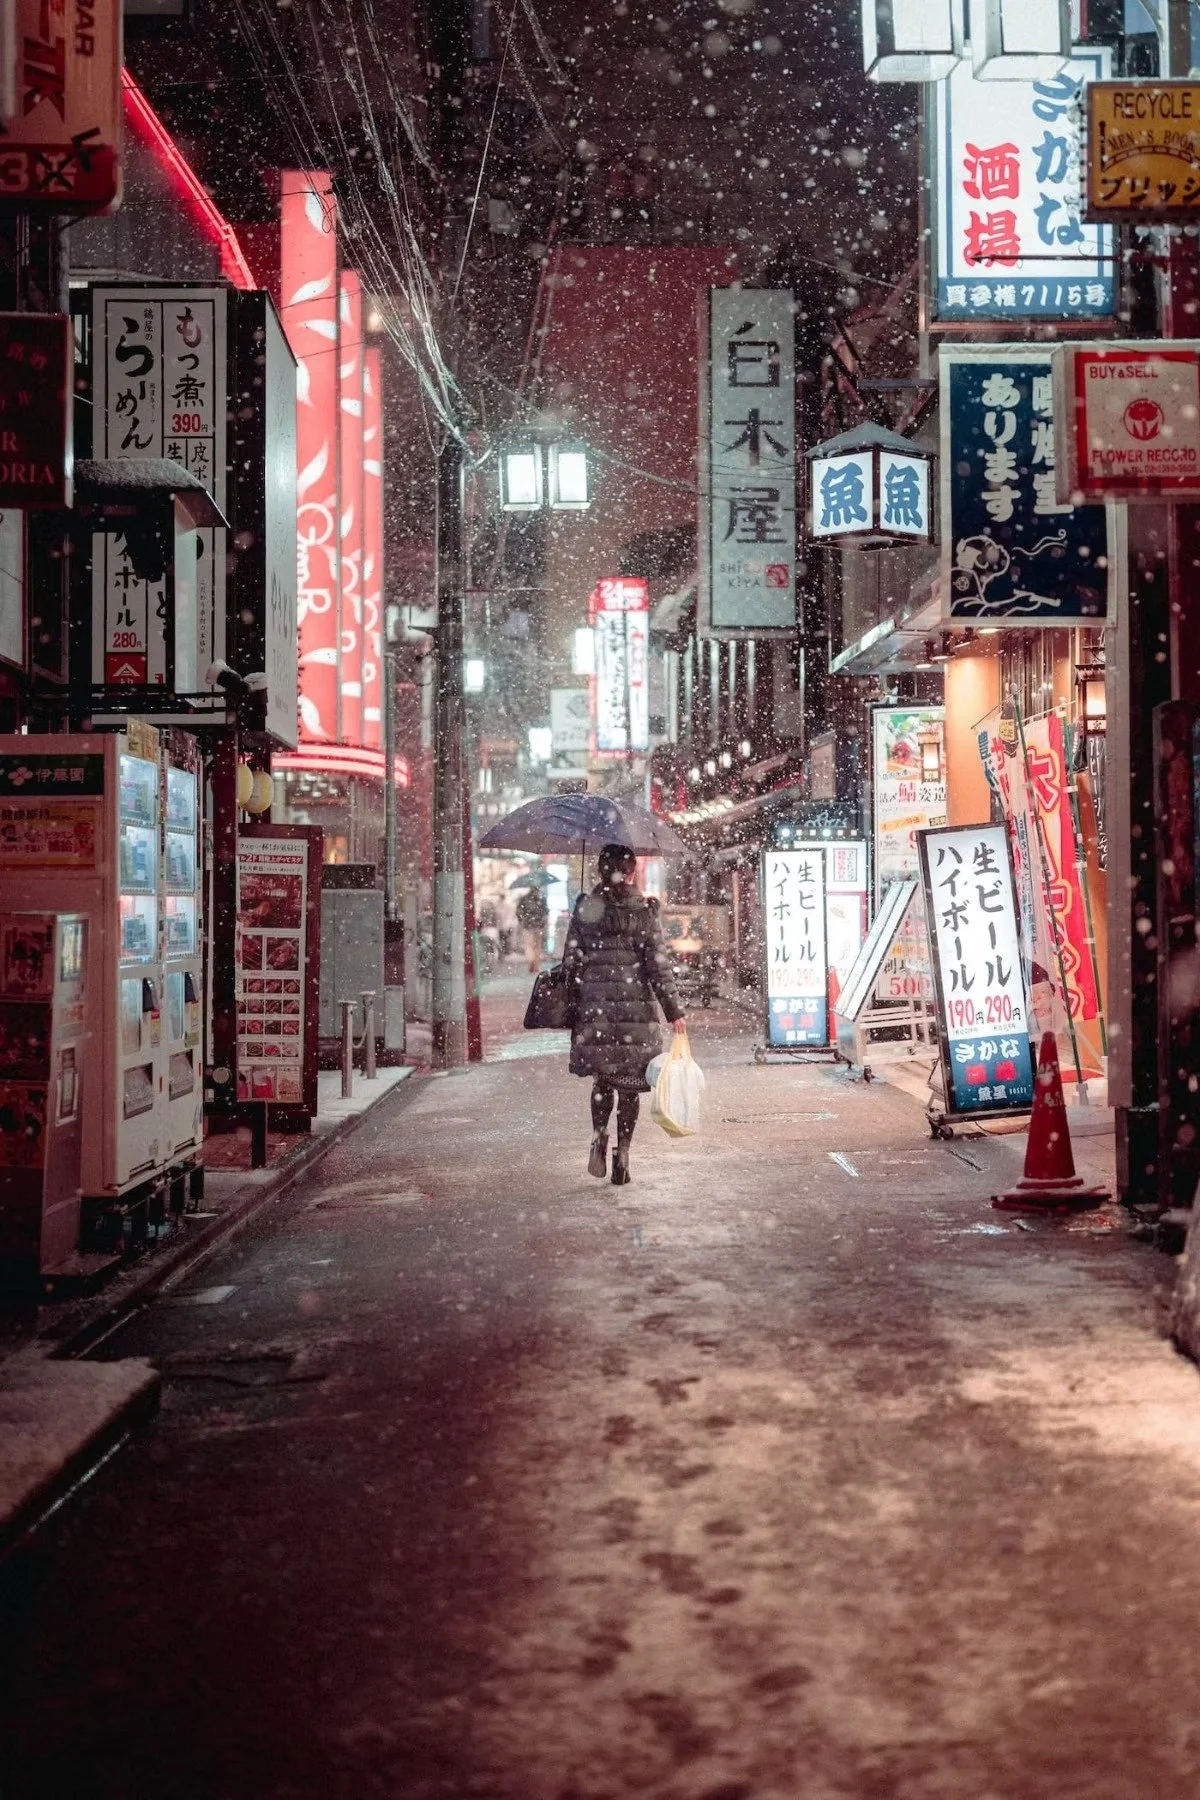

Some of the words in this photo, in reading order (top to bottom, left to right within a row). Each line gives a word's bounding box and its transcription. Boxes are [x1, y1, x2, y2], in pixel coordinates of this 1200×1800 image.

[1114, 92, 1192, 119] RECYCLE
[963, 142, 1021, 268] 酒場
[115, 317, 154, 450] らーめん
[172, 306, 206, 409] もつ煮
[721, 321, 789, 542] 白木屋
[982, 373, 1022, 523] あります
[1092, 449, 1143, 463] FLOWER
[820, 463, 867, 528] 魚
[884, 463, 923, 529] 魚
[798, 861, 817, 961] 生ビール
[937, 846, 975, 993] ハイボール
[973, 842, 1012, 988] 生ビール
[949, 999, 984, 1028] 190円
[985, 995, 1021, 1024] 290円
[955, 1038, 1020, 1063] さかな
